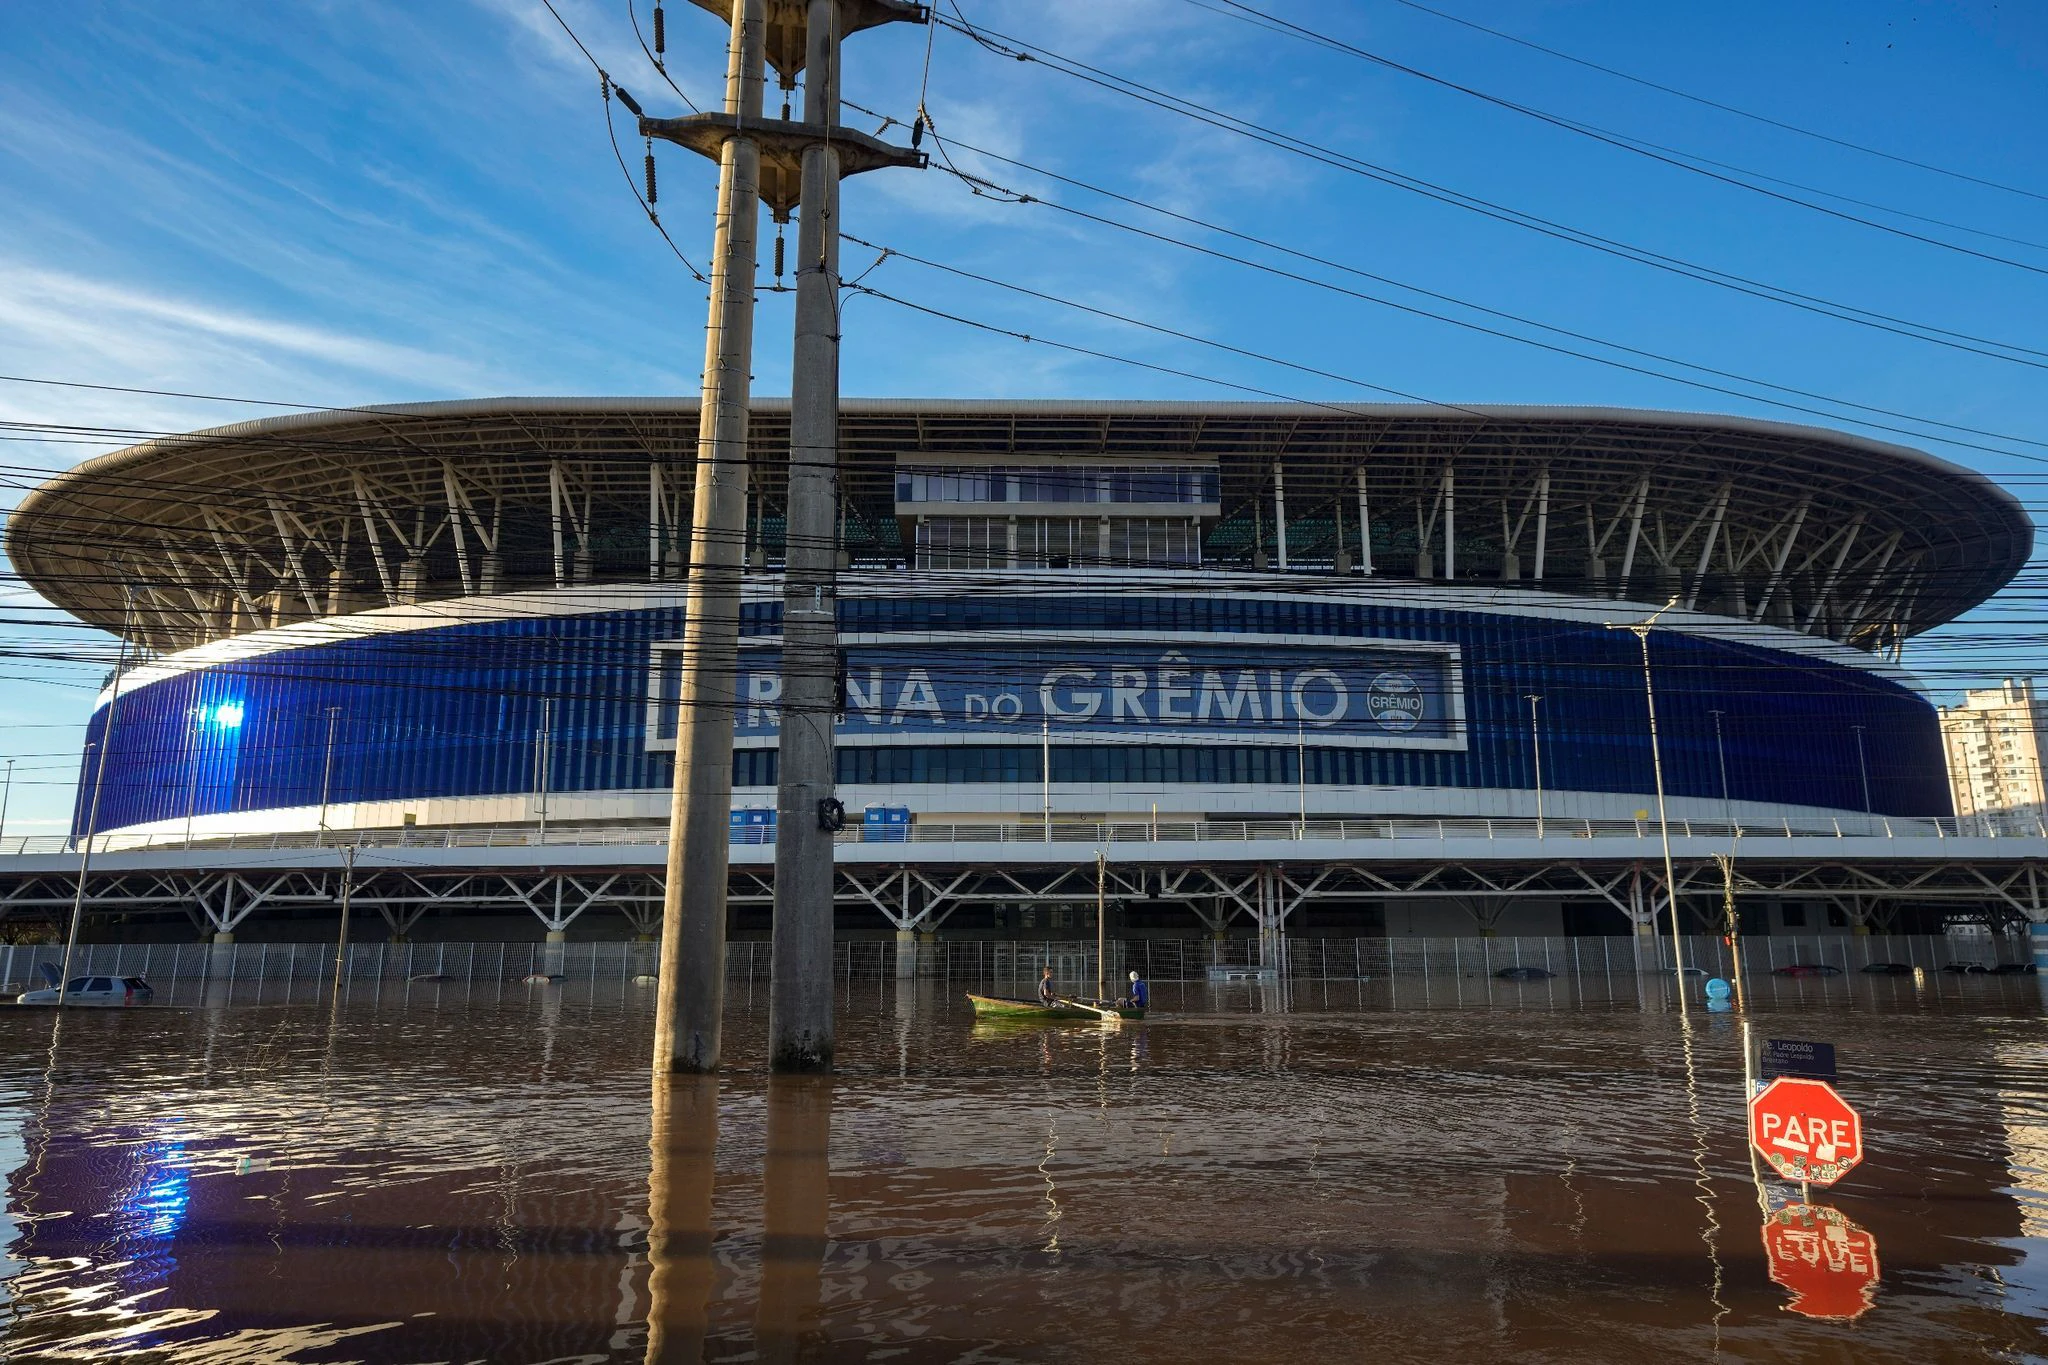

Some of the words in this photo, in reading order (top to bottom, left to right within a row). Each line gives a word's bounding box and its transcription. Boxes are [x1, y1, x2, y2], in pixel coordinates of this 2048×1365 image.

[733, 667, 946, 727] RNA
[965, 693, 1023, 724] DO
[1040, 650, 1349, 728] GRÊMIO
[1370, 693, 1421, 710] GRÊMIO
[1777, 1041, 1813, 1053] Leopoldo
[1762, 1112, 1851, 1148] PARE
